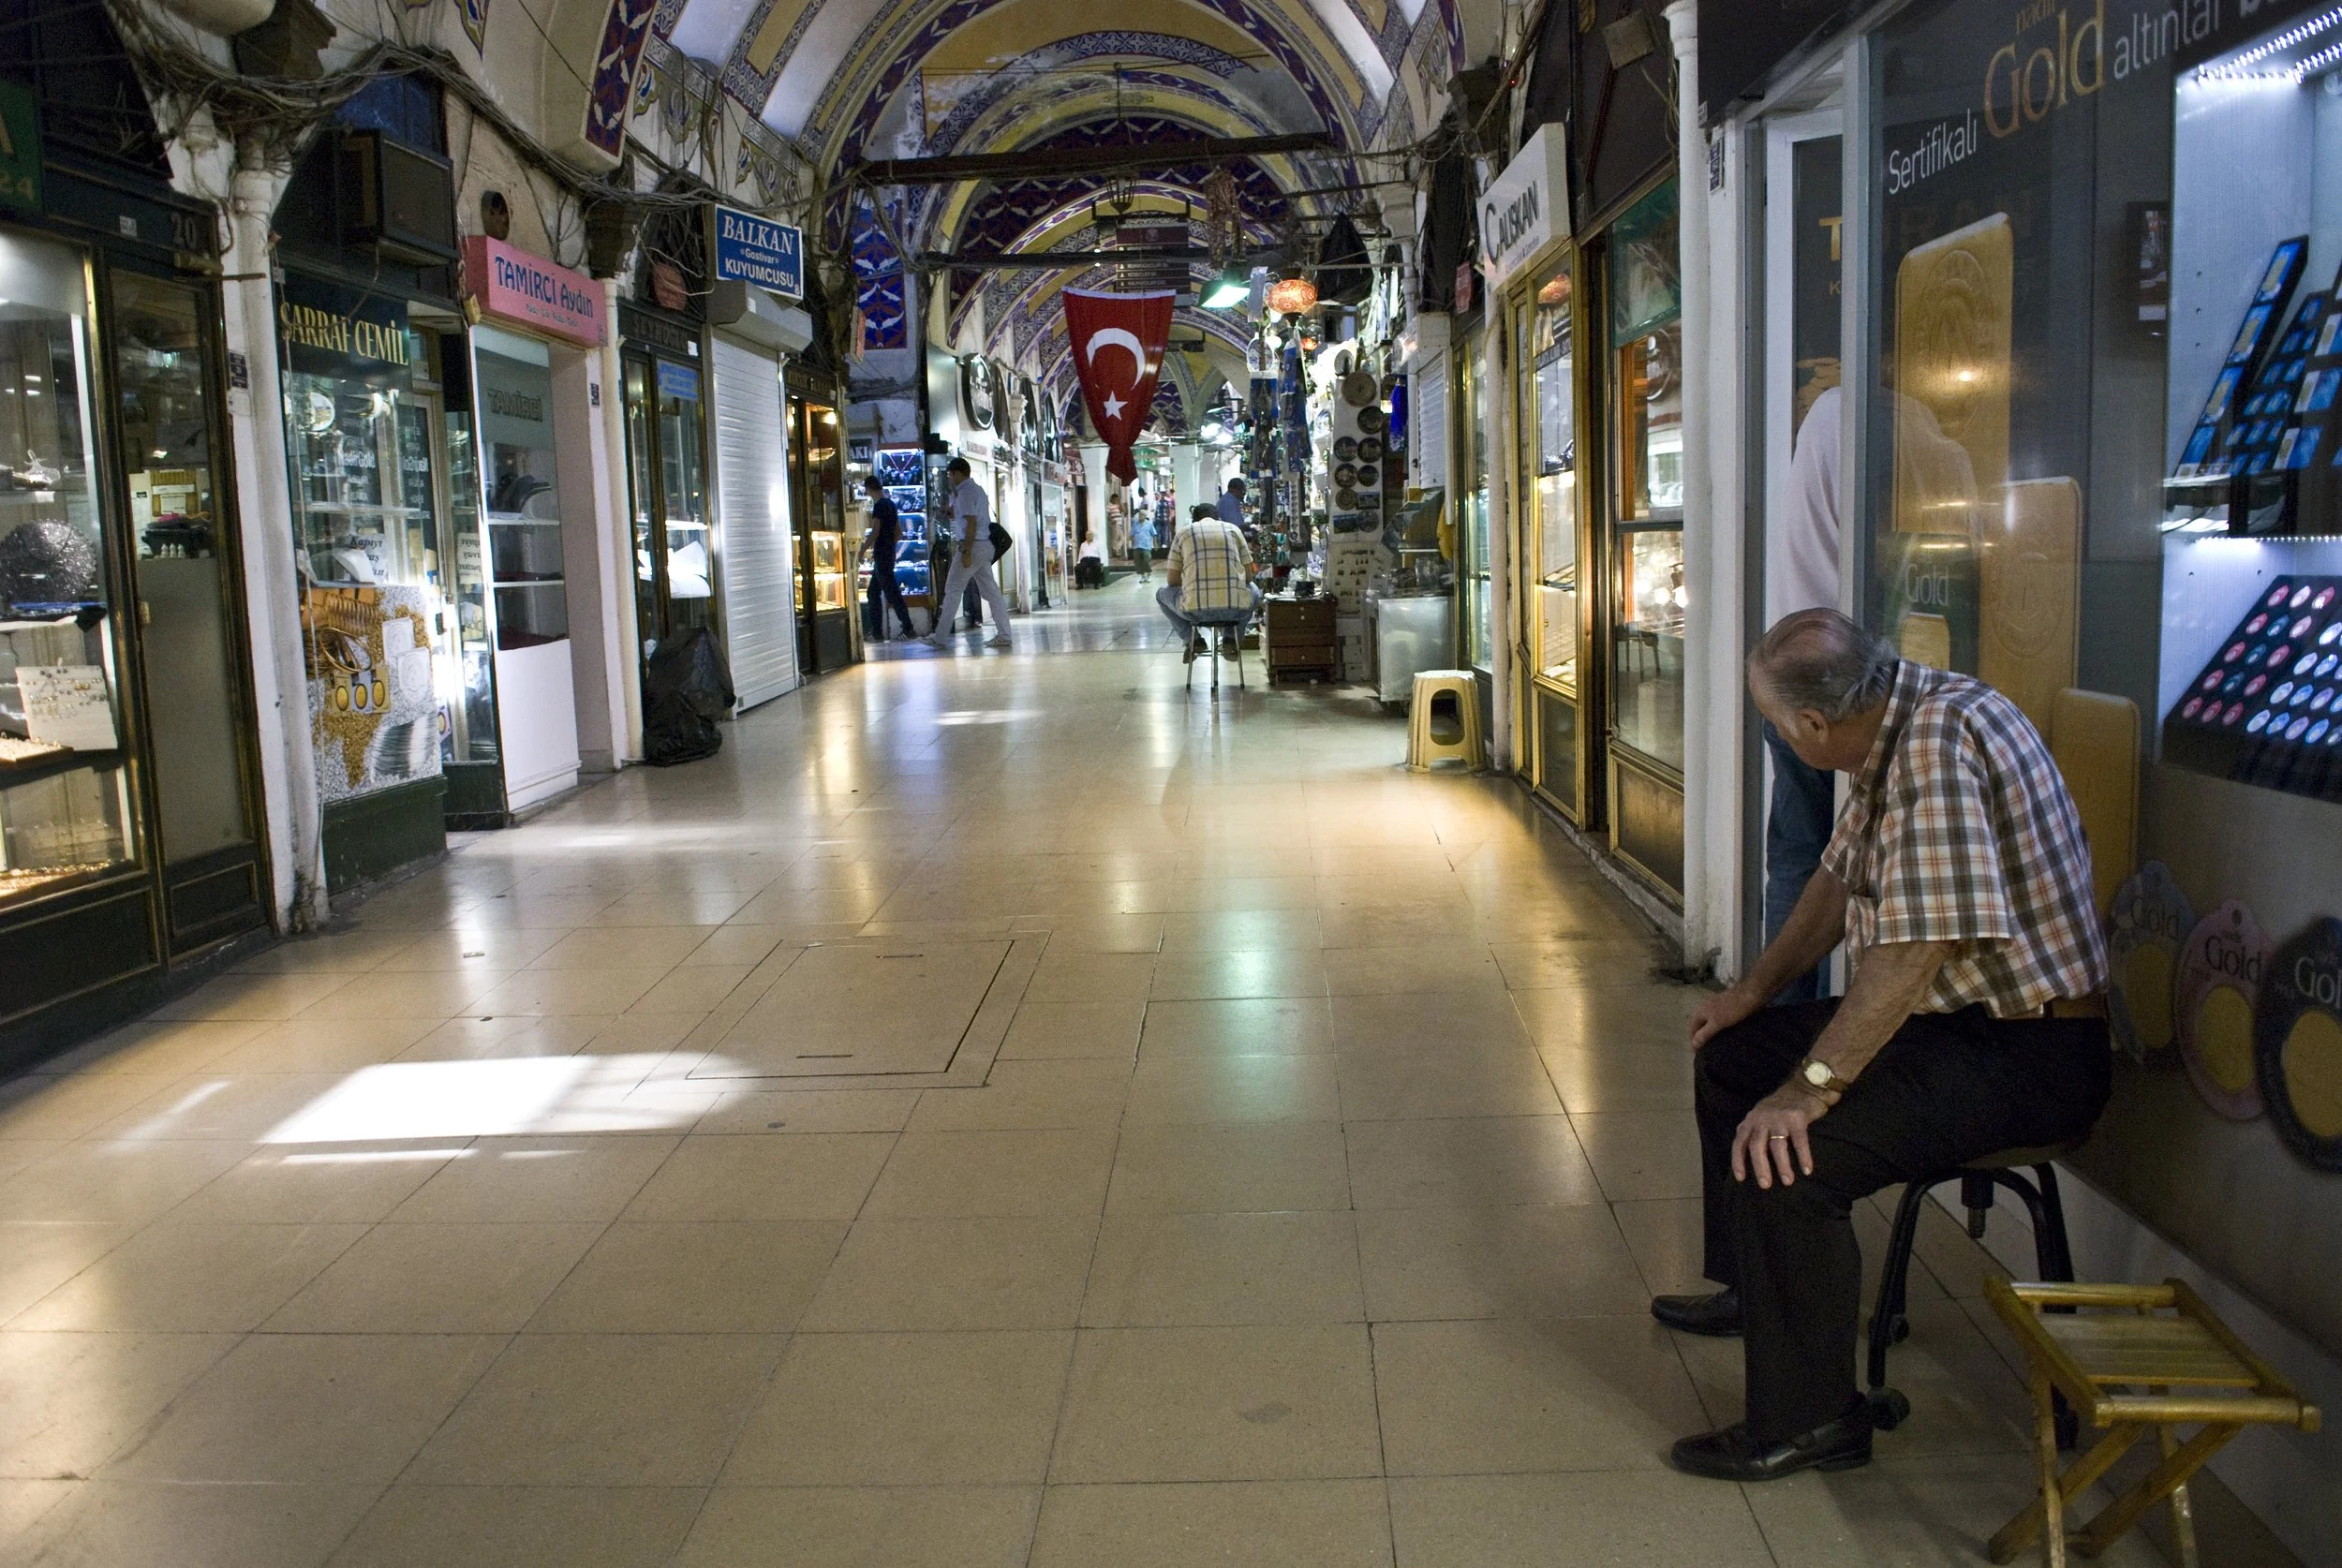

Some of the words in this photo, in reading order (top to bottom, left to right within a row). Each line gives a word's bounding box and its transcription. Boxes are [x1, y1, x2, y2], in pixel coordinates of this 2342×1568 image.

[1889, 108, 1977, 195] Sertifikalı
[1984, 0, 2104, 138] Gold
[722, 215, 793, 255] BALKAN
[495, 256, 556, 305] TAMİRCİ
[560, 283, 593, 318] Aydın
[725, 258, 794, 288] KUYUMCUSU
[354, 318, 408, 366] CEMİL
[1905, 563, 1949, 606] Gold
[2205, 936, 2262, 984] Gold
